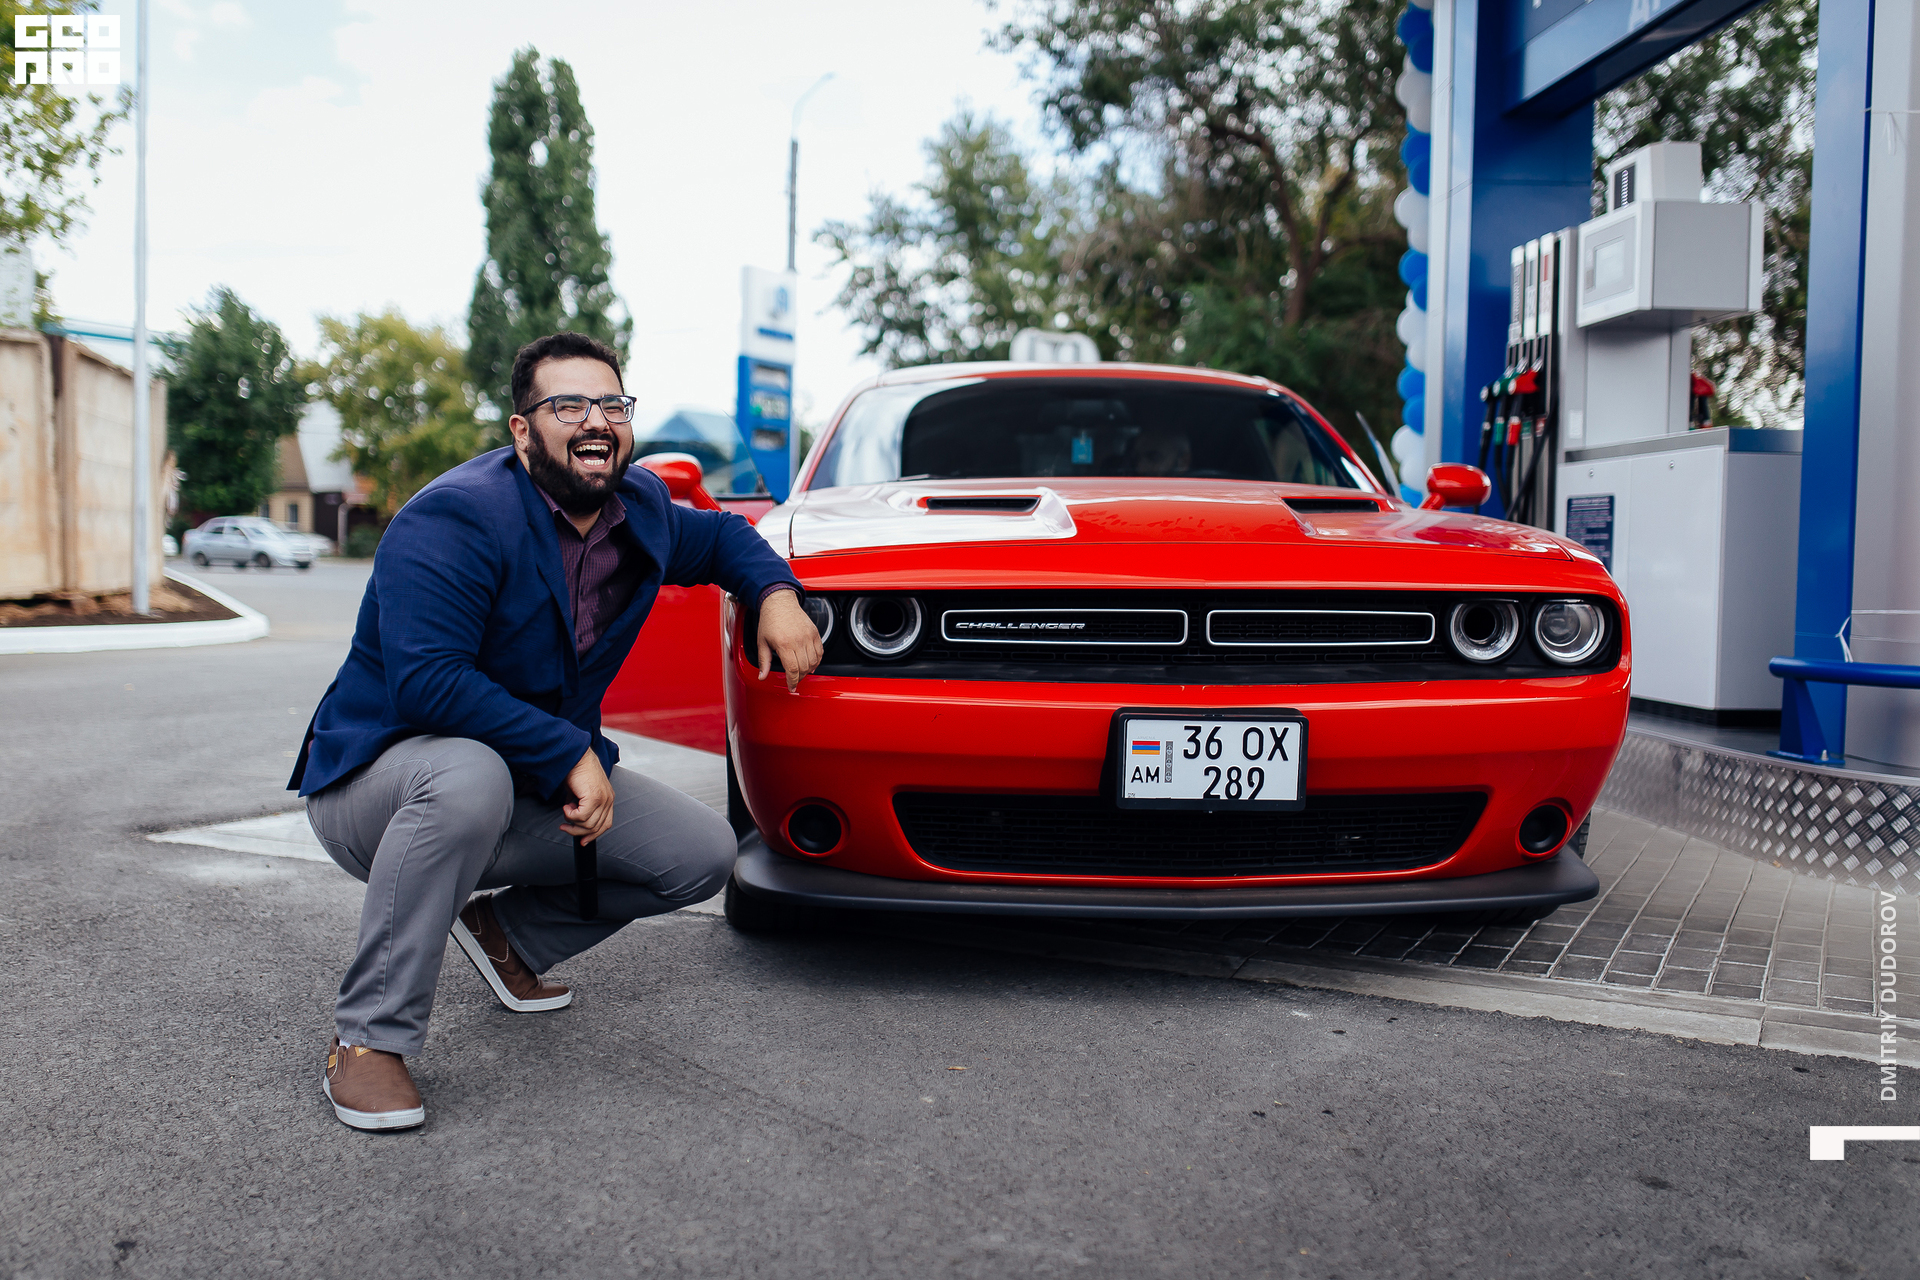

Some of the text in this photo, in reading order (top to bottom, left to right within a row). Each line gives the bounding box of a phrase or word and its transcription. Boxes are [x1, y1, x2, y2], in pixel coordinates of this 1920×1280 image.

[955, 622, 1086, 630] CHALLENGER
[1183, 725, 1290, 761] 36 OX
[1130, 765, 1160, 784] AM
[1202, 766, 1265, 800] 289
